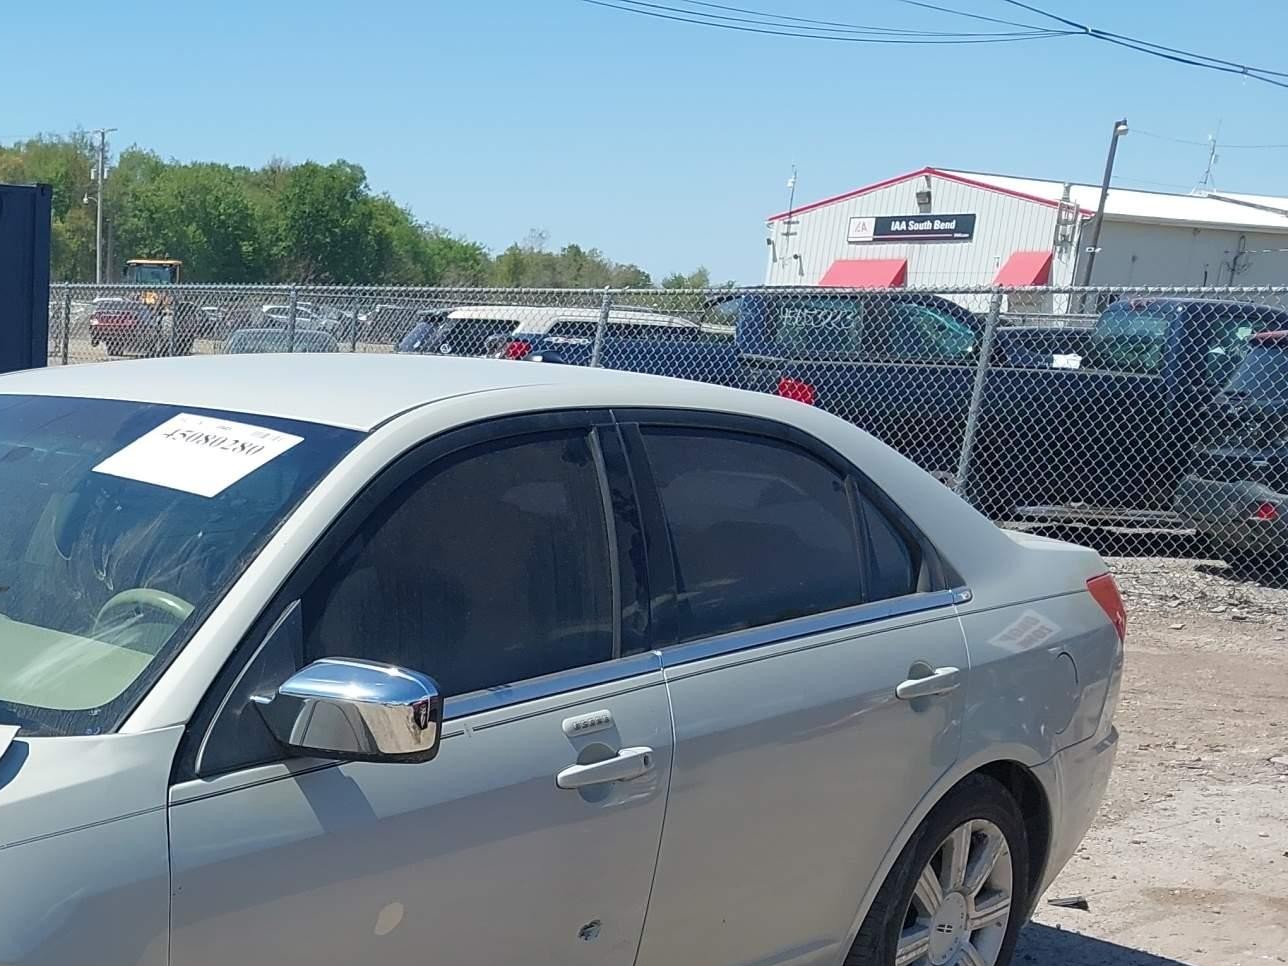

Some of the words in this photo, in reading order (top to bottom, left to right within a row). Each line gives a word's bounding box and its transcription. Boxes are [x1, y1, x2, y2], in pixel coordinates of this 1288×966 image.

[890, 221, 907, 231] IAA
[908, 220, 932, 231] South
[933, 219, 956, 230] Bend
[163, 428, 264, 455] 45080280
